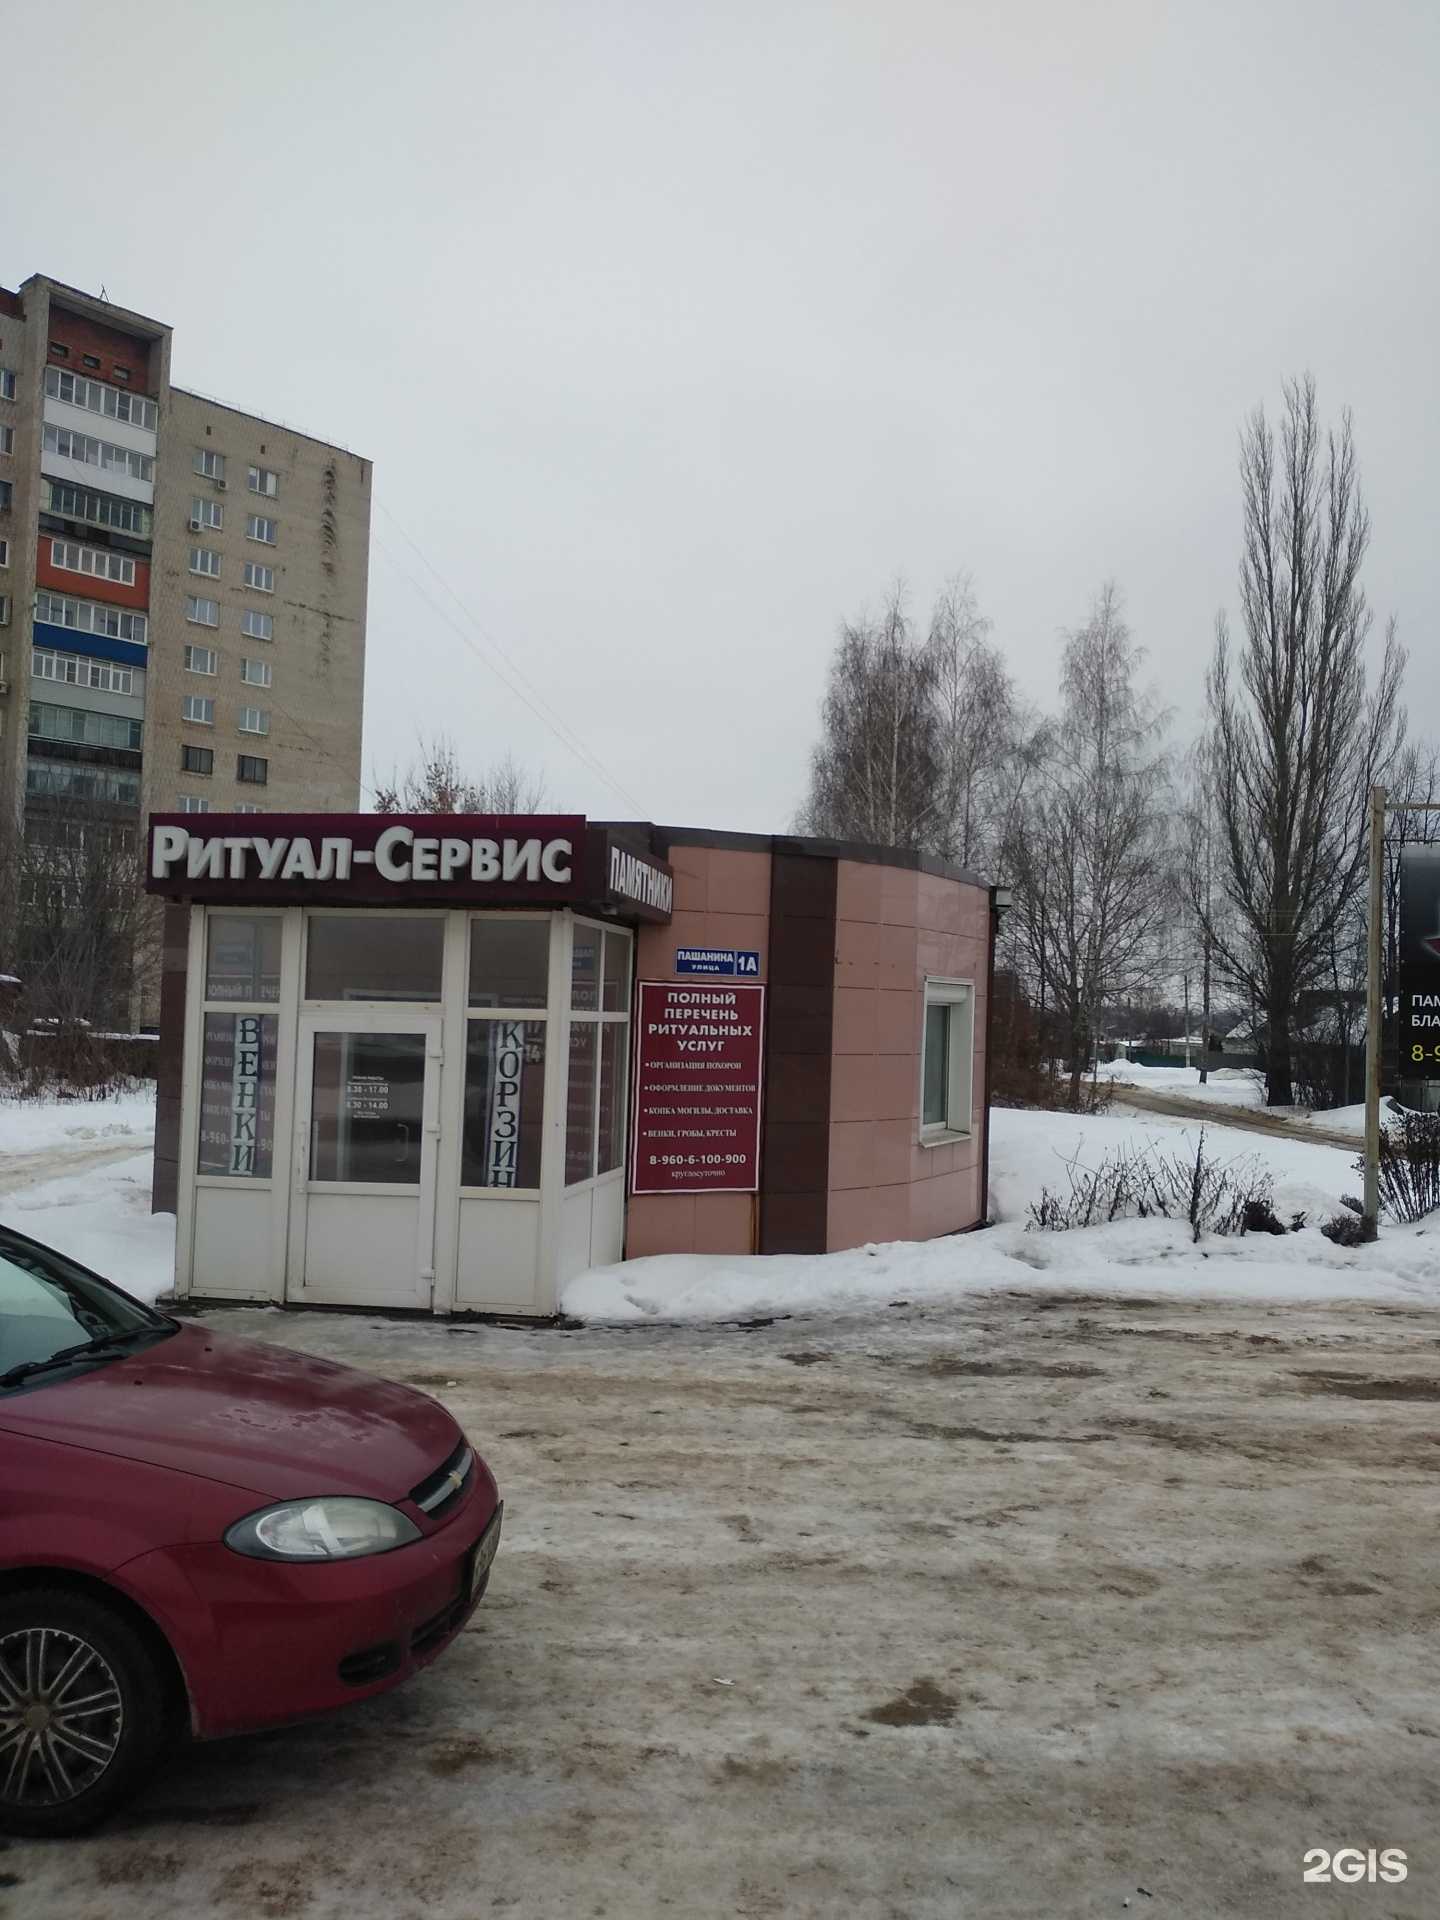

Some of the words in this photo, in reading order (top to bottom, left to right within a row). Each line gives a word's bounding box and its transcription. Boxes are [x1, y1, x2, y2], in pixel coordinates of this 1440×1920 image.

[610, 846, 673, 914] ПАМЯТНИКИ
[677, 951, 734, 962] ПАШАНИНА
[667, 992, 736, 1005] ПОЛНЫЙ
[664, 1008, 739, 1020] ПЕРЕЧЕНЬ
[648, 1023, 753, 1036] РИТУАЛЬНЫХ
[677, 1040, 725, 1051] УСЛУГ
[704, 1084, 756, 1092] ДОКУМЕНТОВ
[232, 1018, 259, 1172] ВЕНКИ
[648, 1107, 676, 1115] КОПКА
[714, 1107, 753, 1115] ДОСТАВКА
[706, 1129, 737, 1137] КРЕСТЫ
[649, 1154, 746, 1165] 8-960-6-100-900
